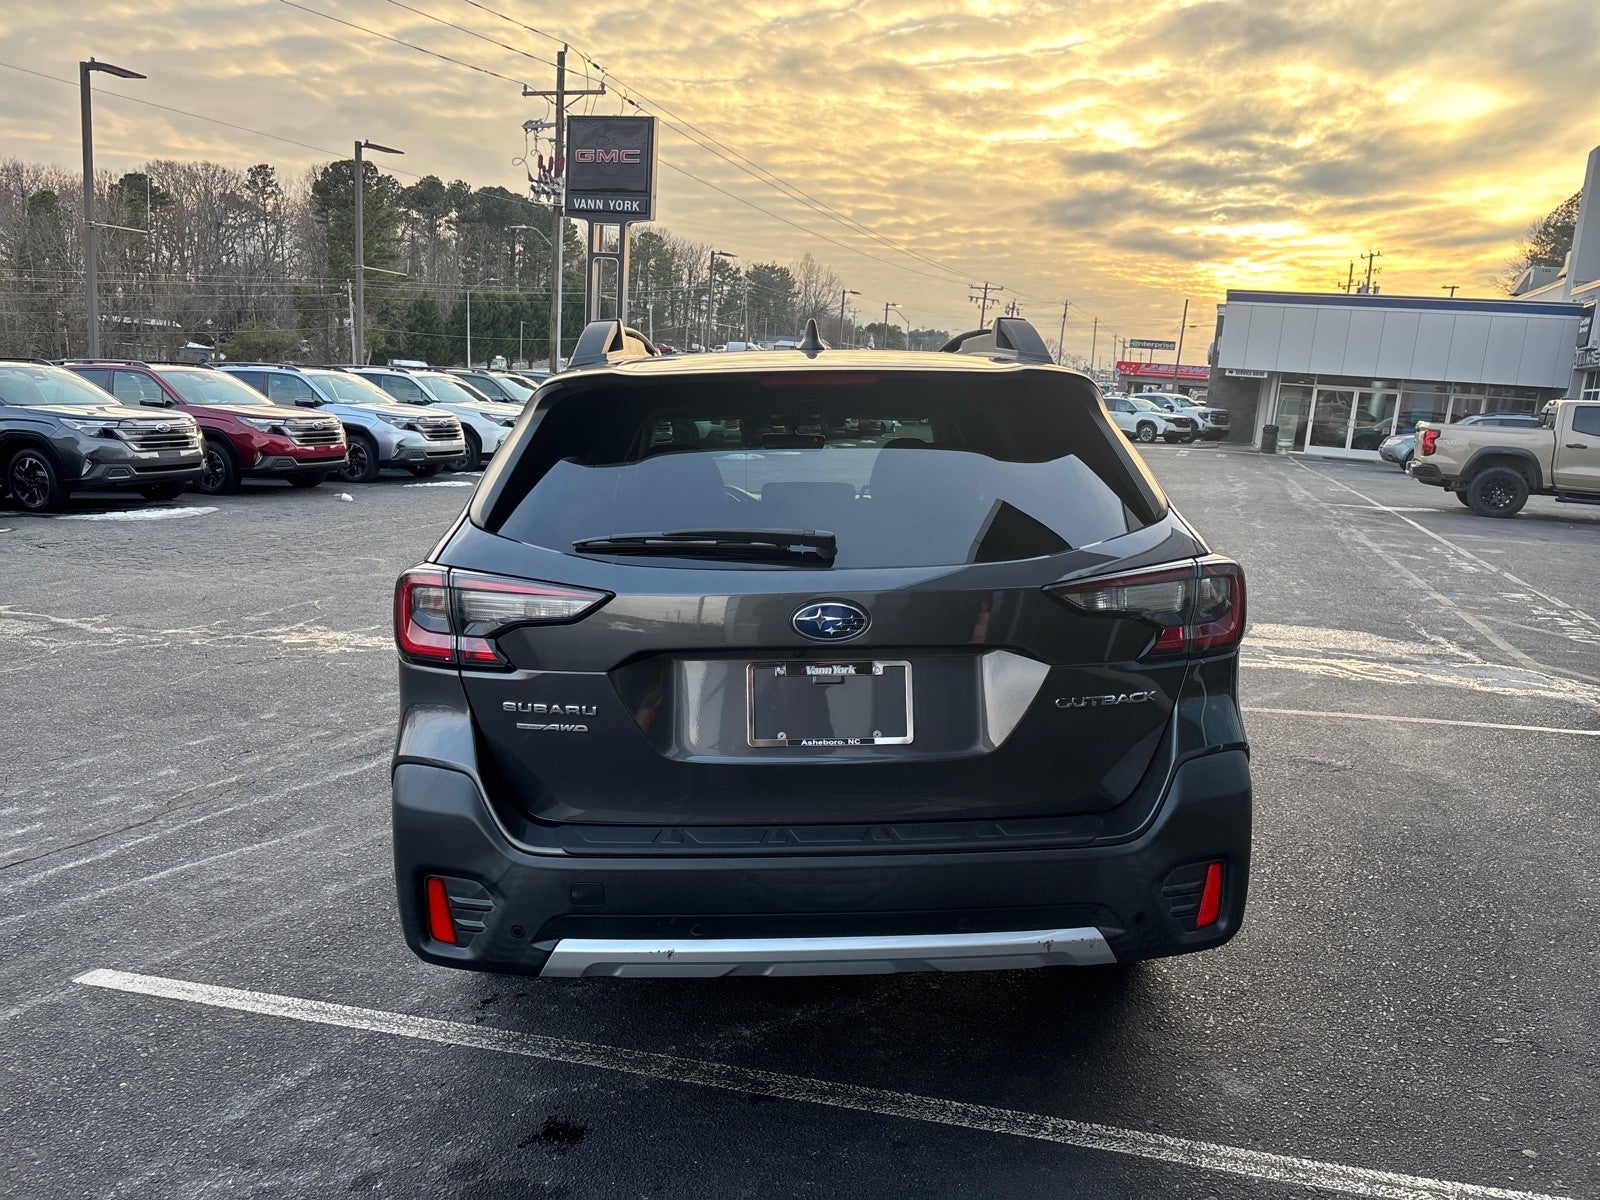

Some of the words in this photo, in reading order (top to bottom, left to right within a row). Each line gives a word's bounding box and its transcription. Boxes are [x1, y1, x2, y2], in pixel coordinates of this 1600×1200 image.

[575, 149, 641, 164] GMC
[573, 198, 604, 210] VANN
[608, 200, 640, 212] YORK
[1131, 340, 1175, 350] enterprise
[1055, 690, 1157, 708] OUTBACK
[502, 701, 597, 716] SUBARU
[542, 723, 588, 732] AWD
